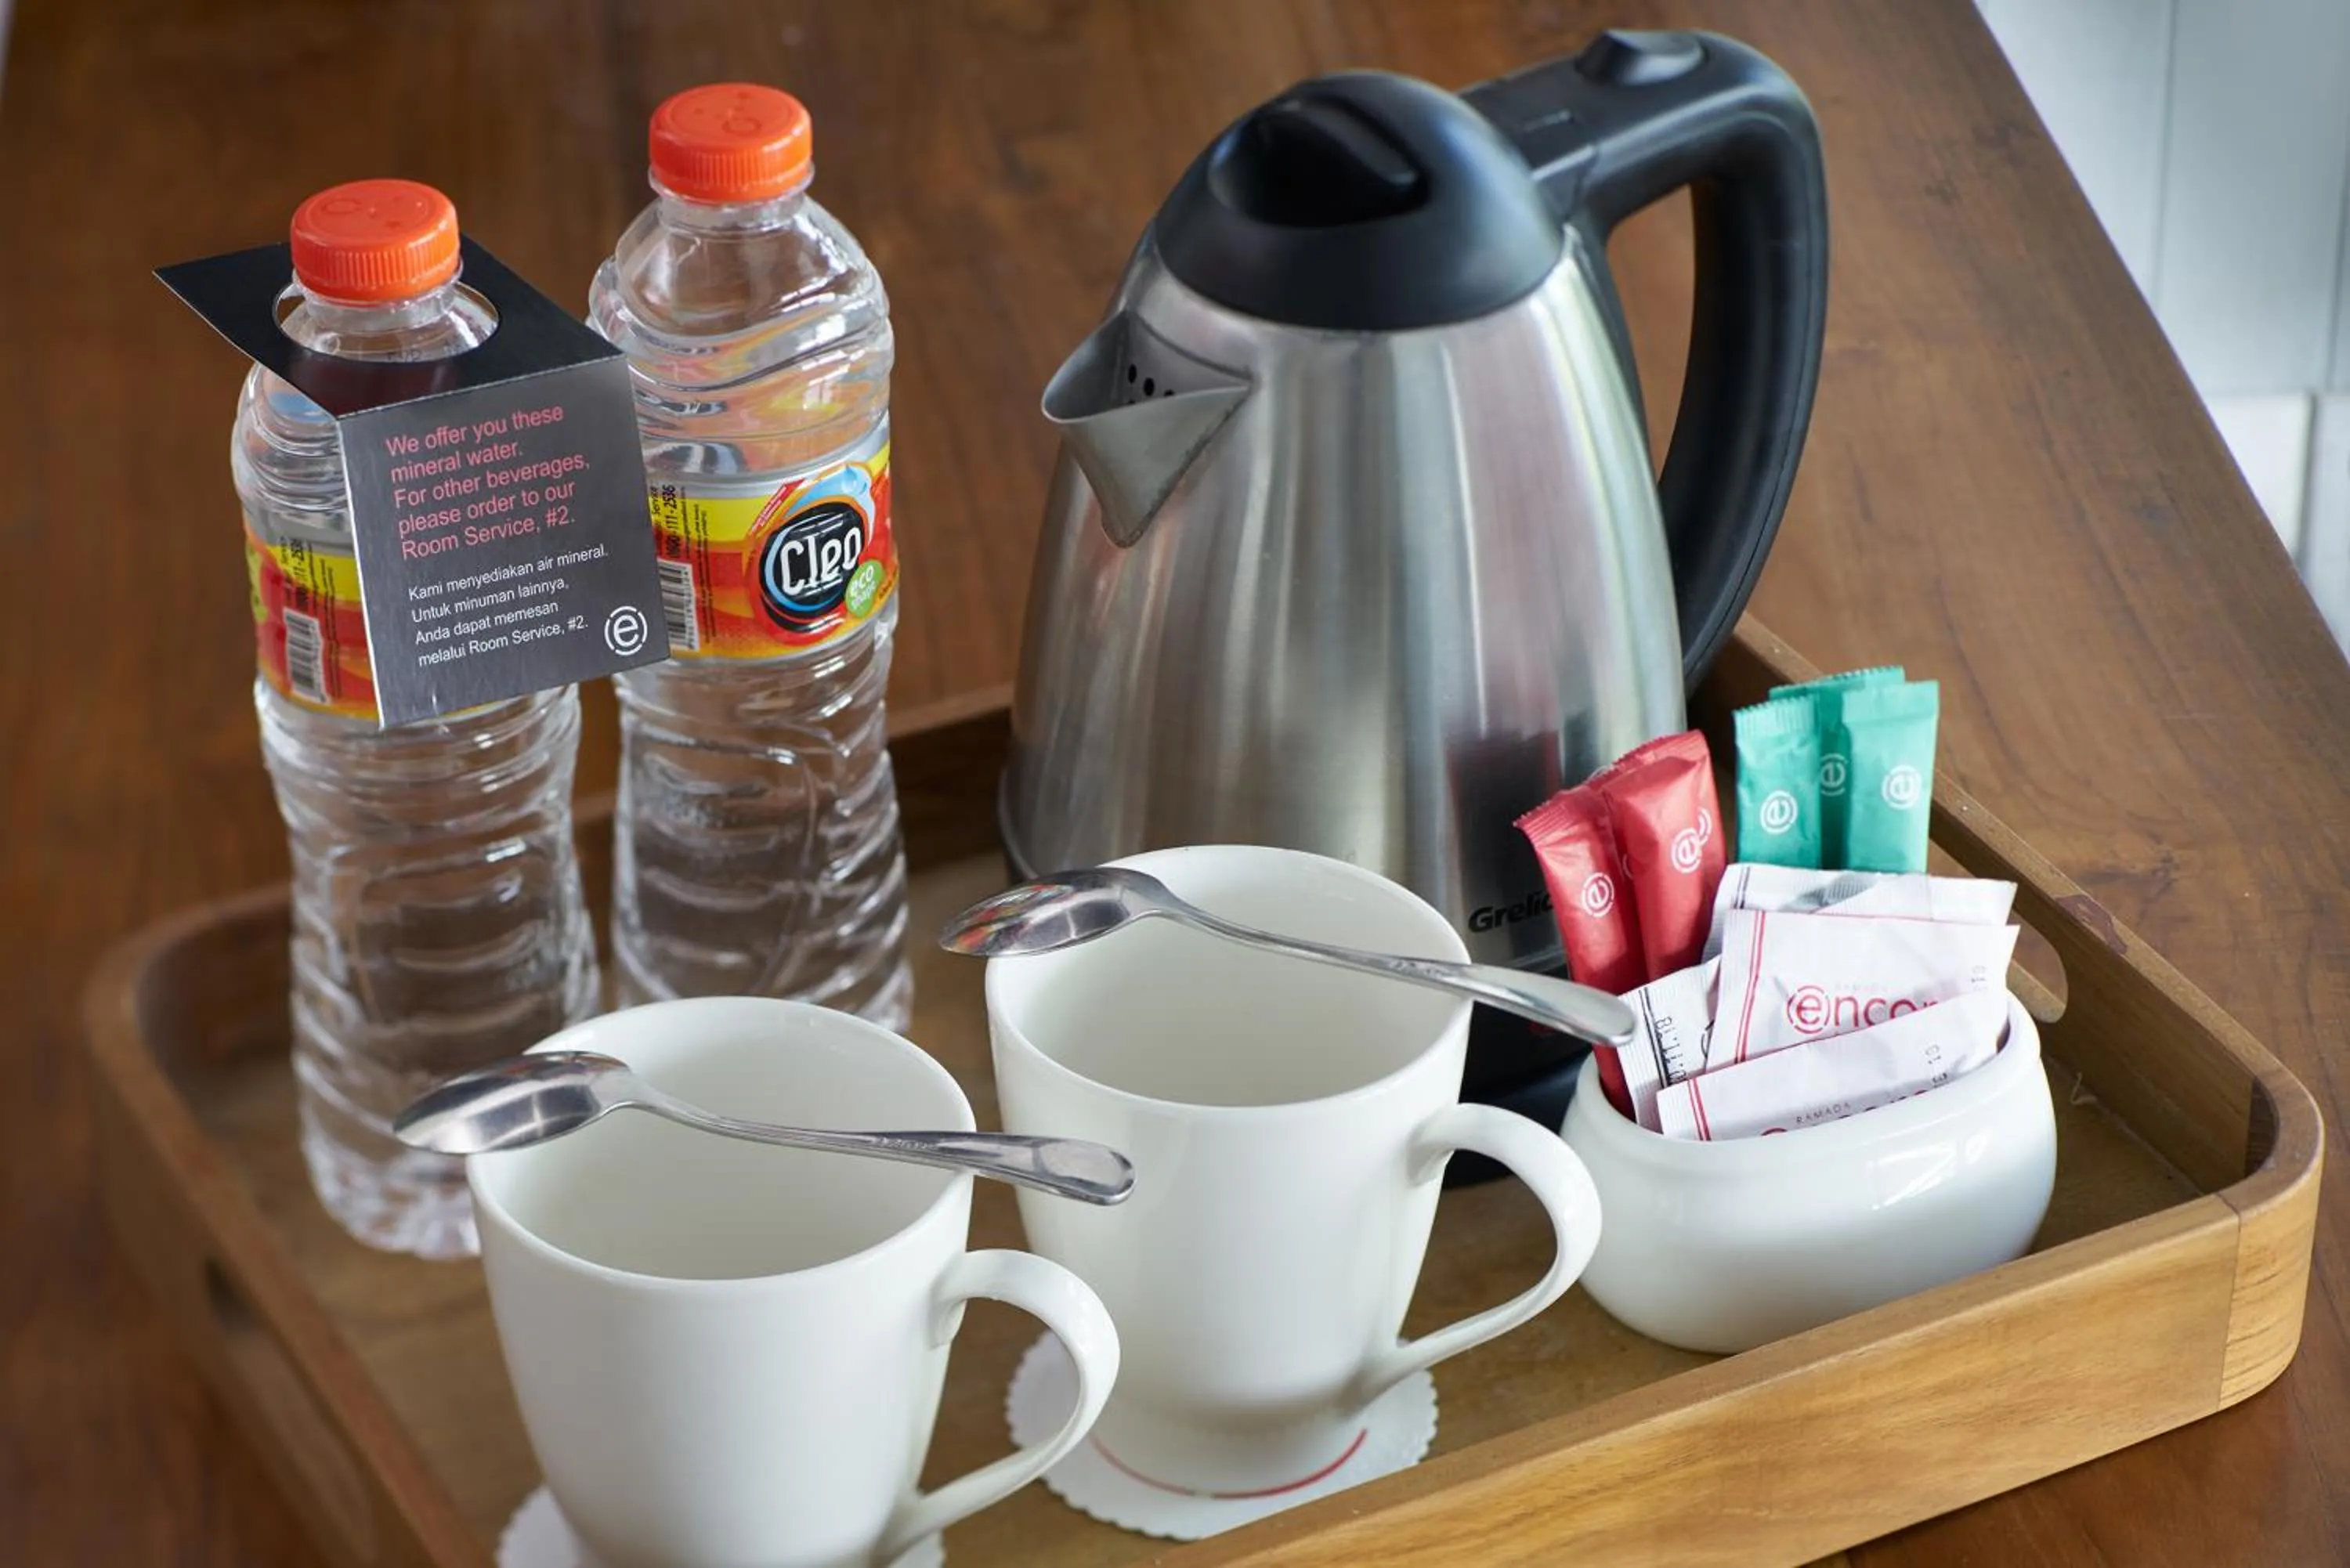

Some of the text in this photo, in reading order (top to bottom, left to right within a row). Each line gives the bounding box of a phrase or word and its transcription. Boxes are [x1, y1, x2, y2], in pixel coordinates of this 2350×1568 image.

[385, 405, 564, 457] We offer you these
[392, 441, 523, 484] mineral water.
[394, 453, 590, 509] For other beverages,
[399, 481, 576, 540] please order to our
[401, 504, 576, 561] Room Service, #2.
[408, 543, 609, 602] Kami menyediakan air mineral.
[779, 526, 862, 596] Cleo
[411, 602, 452, 623] Untuk
[454, 588, 515, 613] minuman
[415, 601, 559, 645] Anda dapat memesan
[418, 614, 588, 667] melalui Room Service, #2.
[1787, 985, 1939, 1035] enco
[1796, 1101, 1852, 1125] RAMADA
